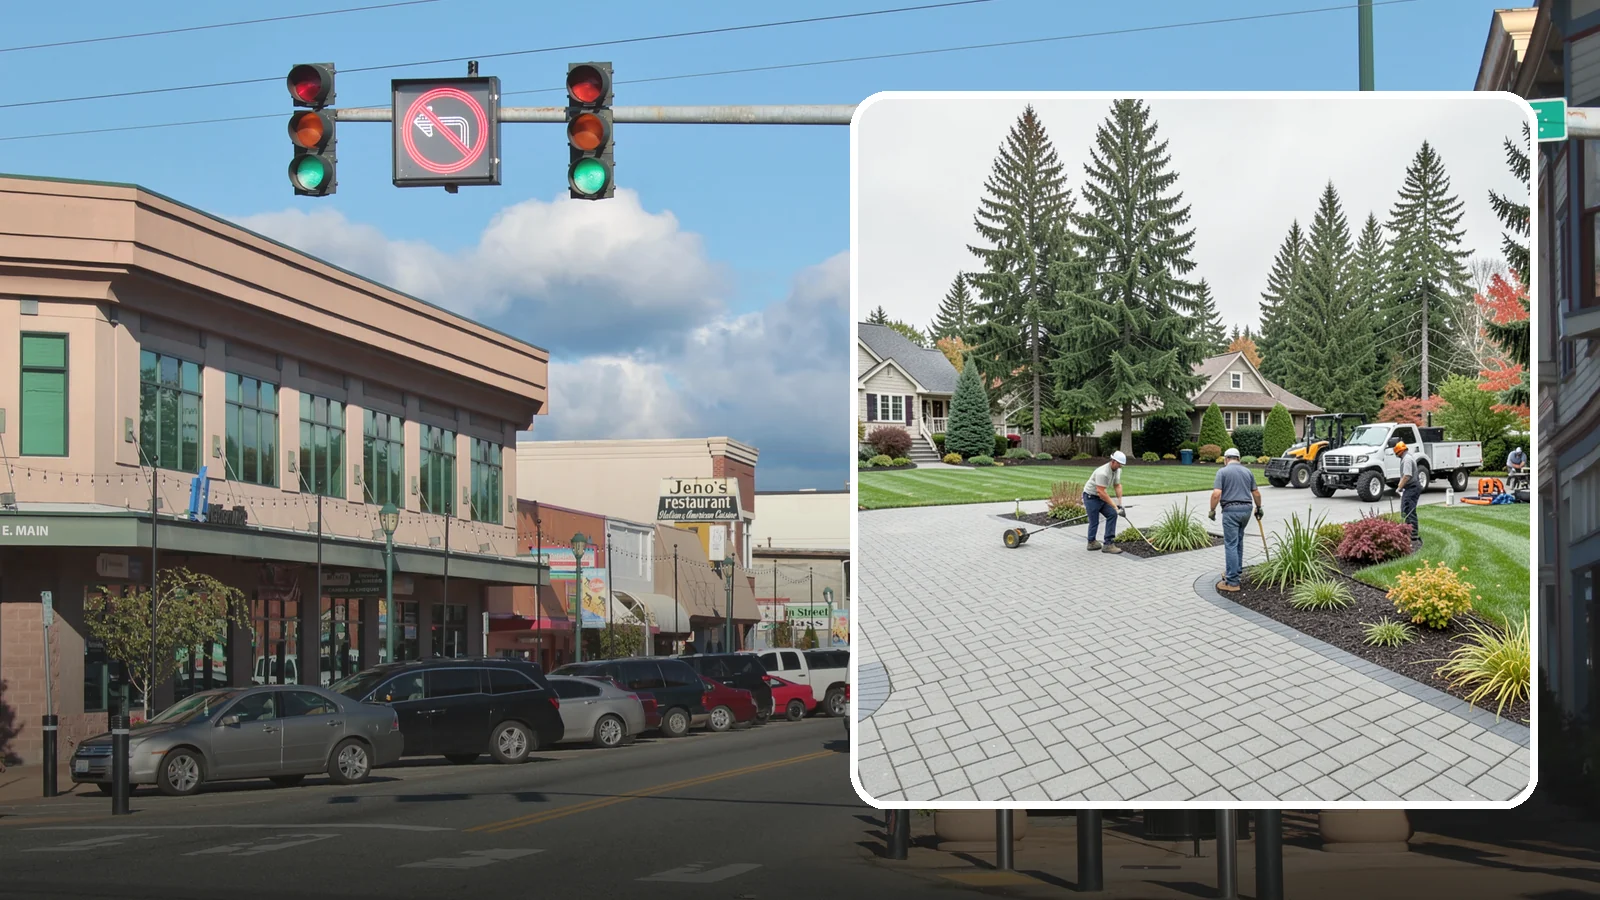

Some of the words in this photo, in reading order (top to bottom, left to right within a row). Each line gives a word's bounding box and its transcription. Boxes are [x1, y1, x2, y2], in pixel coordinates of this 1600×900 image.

[670, 480, 727, 494] Jeno's
[665, 496, 731, 509] restaurant
[658, 510, 681, 519] Italian
[686, 510, 714, 519] American
[715, 509, 737, 519] Cuisine
[2, 525, 13, 536] E.
[15, 525, 49, 536] MAIN
[797, 608, 828, 617] Street
